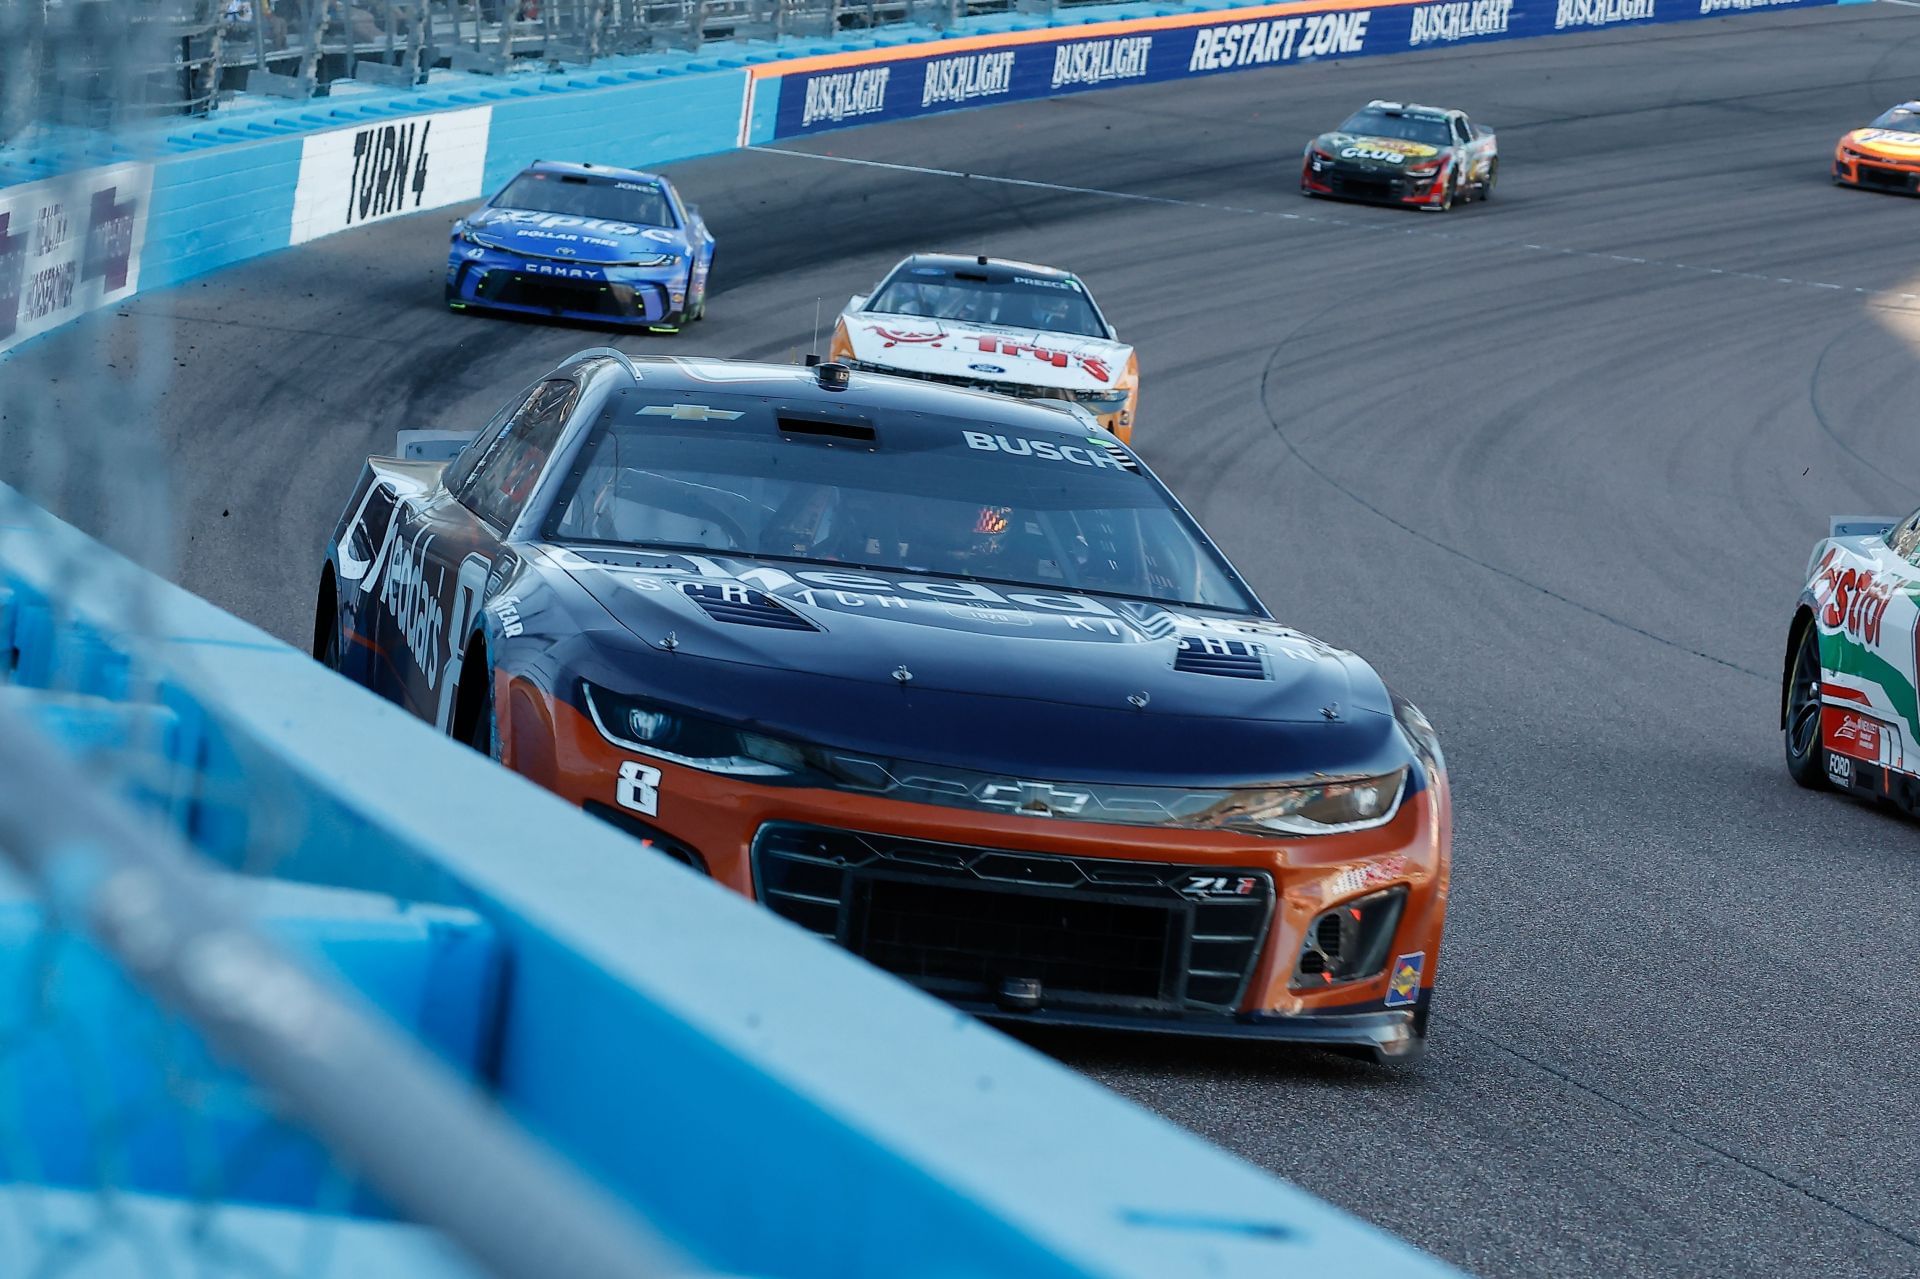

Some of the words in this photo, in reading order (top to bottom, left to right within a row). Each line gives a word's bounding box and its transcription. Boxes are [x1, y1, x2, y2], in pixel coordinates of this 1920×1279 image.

[1189, 18, 1302, 72] RESTART
[1298, 11, 1371, 58] ZONE
[1341, 147, 1405, 164] CLUB
[347, 123, 414, 224] TURN
[412, 120, 430, 206] 4
[614, 182, 659, 194] JONES
[516, 229, 578, 241] DOLLAR
[582, 235, 619, 248] TREE
[1013, 276, 1070, 290] PREECE
[962, 430, 1128, 472] BUSCH
[632, 577, 910, 609] SCRTCH
[1828, 753, 1850, 777] FORD
[616, 760, 662, 817] 8
